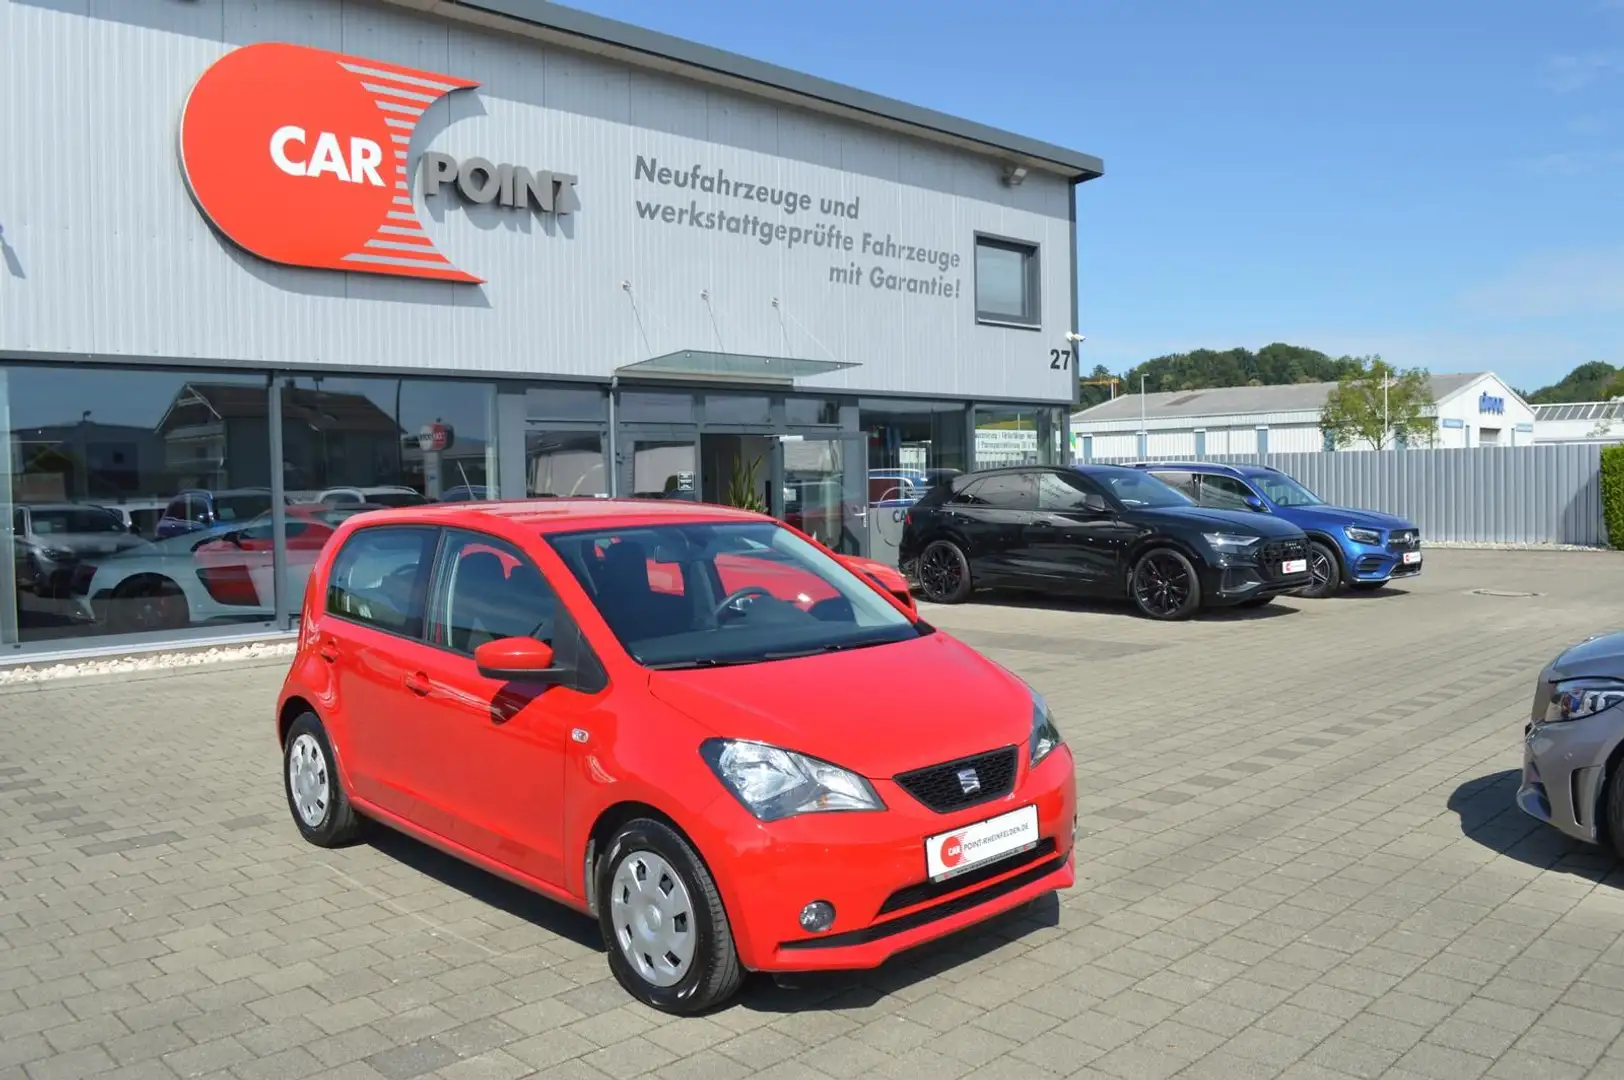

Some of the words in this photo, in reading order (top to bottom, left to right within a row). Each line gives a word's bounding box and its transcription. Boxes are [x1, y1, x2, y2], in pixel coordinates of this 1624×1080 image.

[270, 126, 385, 187] CAR
[422, 151, 579, 215] POINT
[634, 155, 812, 214] Neufahrzeuge
[819, 196, 860, 220] und
[635, 199, 855, 251] werkstattgeprüfte
[861, 231, 961, 271] Fahrzeuge
[828, 263, 863, 286] mit
[869, 266, 961, 298] Garantie!
[1049, 349, 1071, 371] 27
